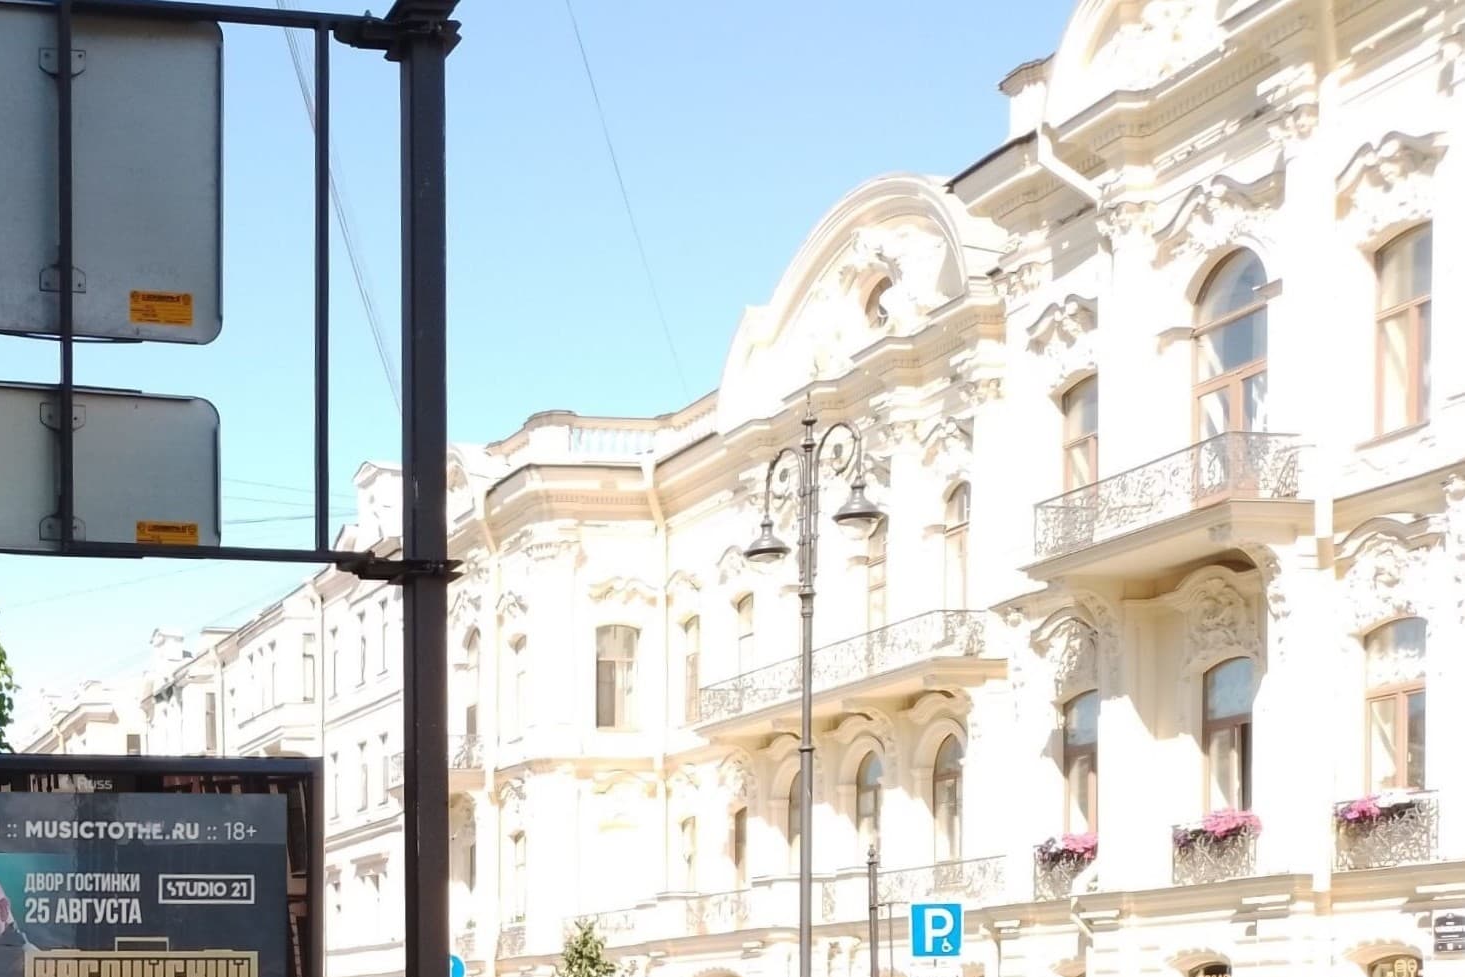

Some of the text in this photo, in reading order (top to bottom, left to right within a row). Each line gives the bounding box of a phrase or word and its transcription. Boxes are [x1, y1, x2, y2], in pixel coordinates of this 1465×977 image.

[25, 821, 199, 840] MUSICTOTHE.RU
[224, 822, 257, 841] 18+
[24, 873, 141, 893] ДВОР ГОСТИНКИ
[166, 881, 247, 898] STUDIO 21
[24, 898, 142, 925] 25 АВГУСТА
[925, 908, 955, 953] P
